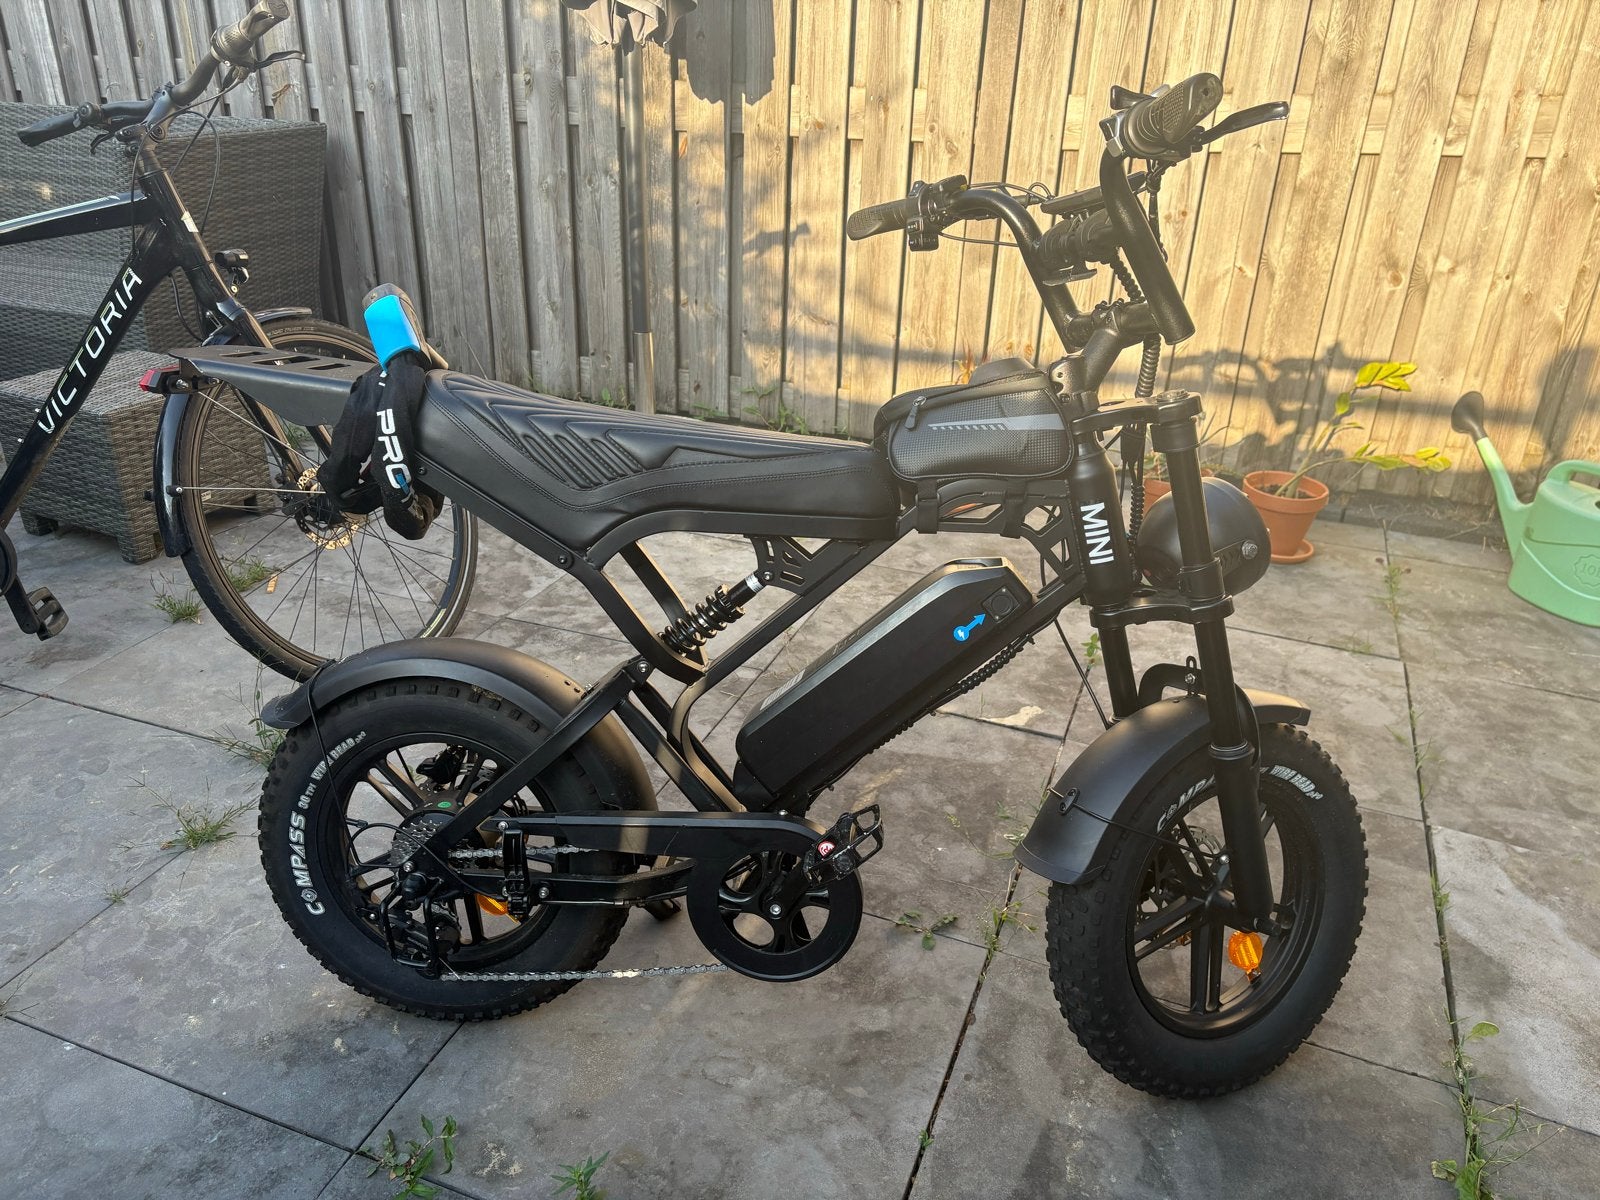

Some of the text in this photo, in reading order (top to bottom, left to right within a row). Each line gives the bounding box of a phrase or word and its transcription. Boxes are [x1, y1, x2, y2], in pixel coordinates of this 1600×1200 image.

[37, 267, 142, 434] VICTORIA
[1080, 502, 1115, 565] MINI
[1269, 764, 1298, 781] WIRE
[1288, 773, 1316, 793] BEAD
[288, 810, 326, 916] COMPASS
